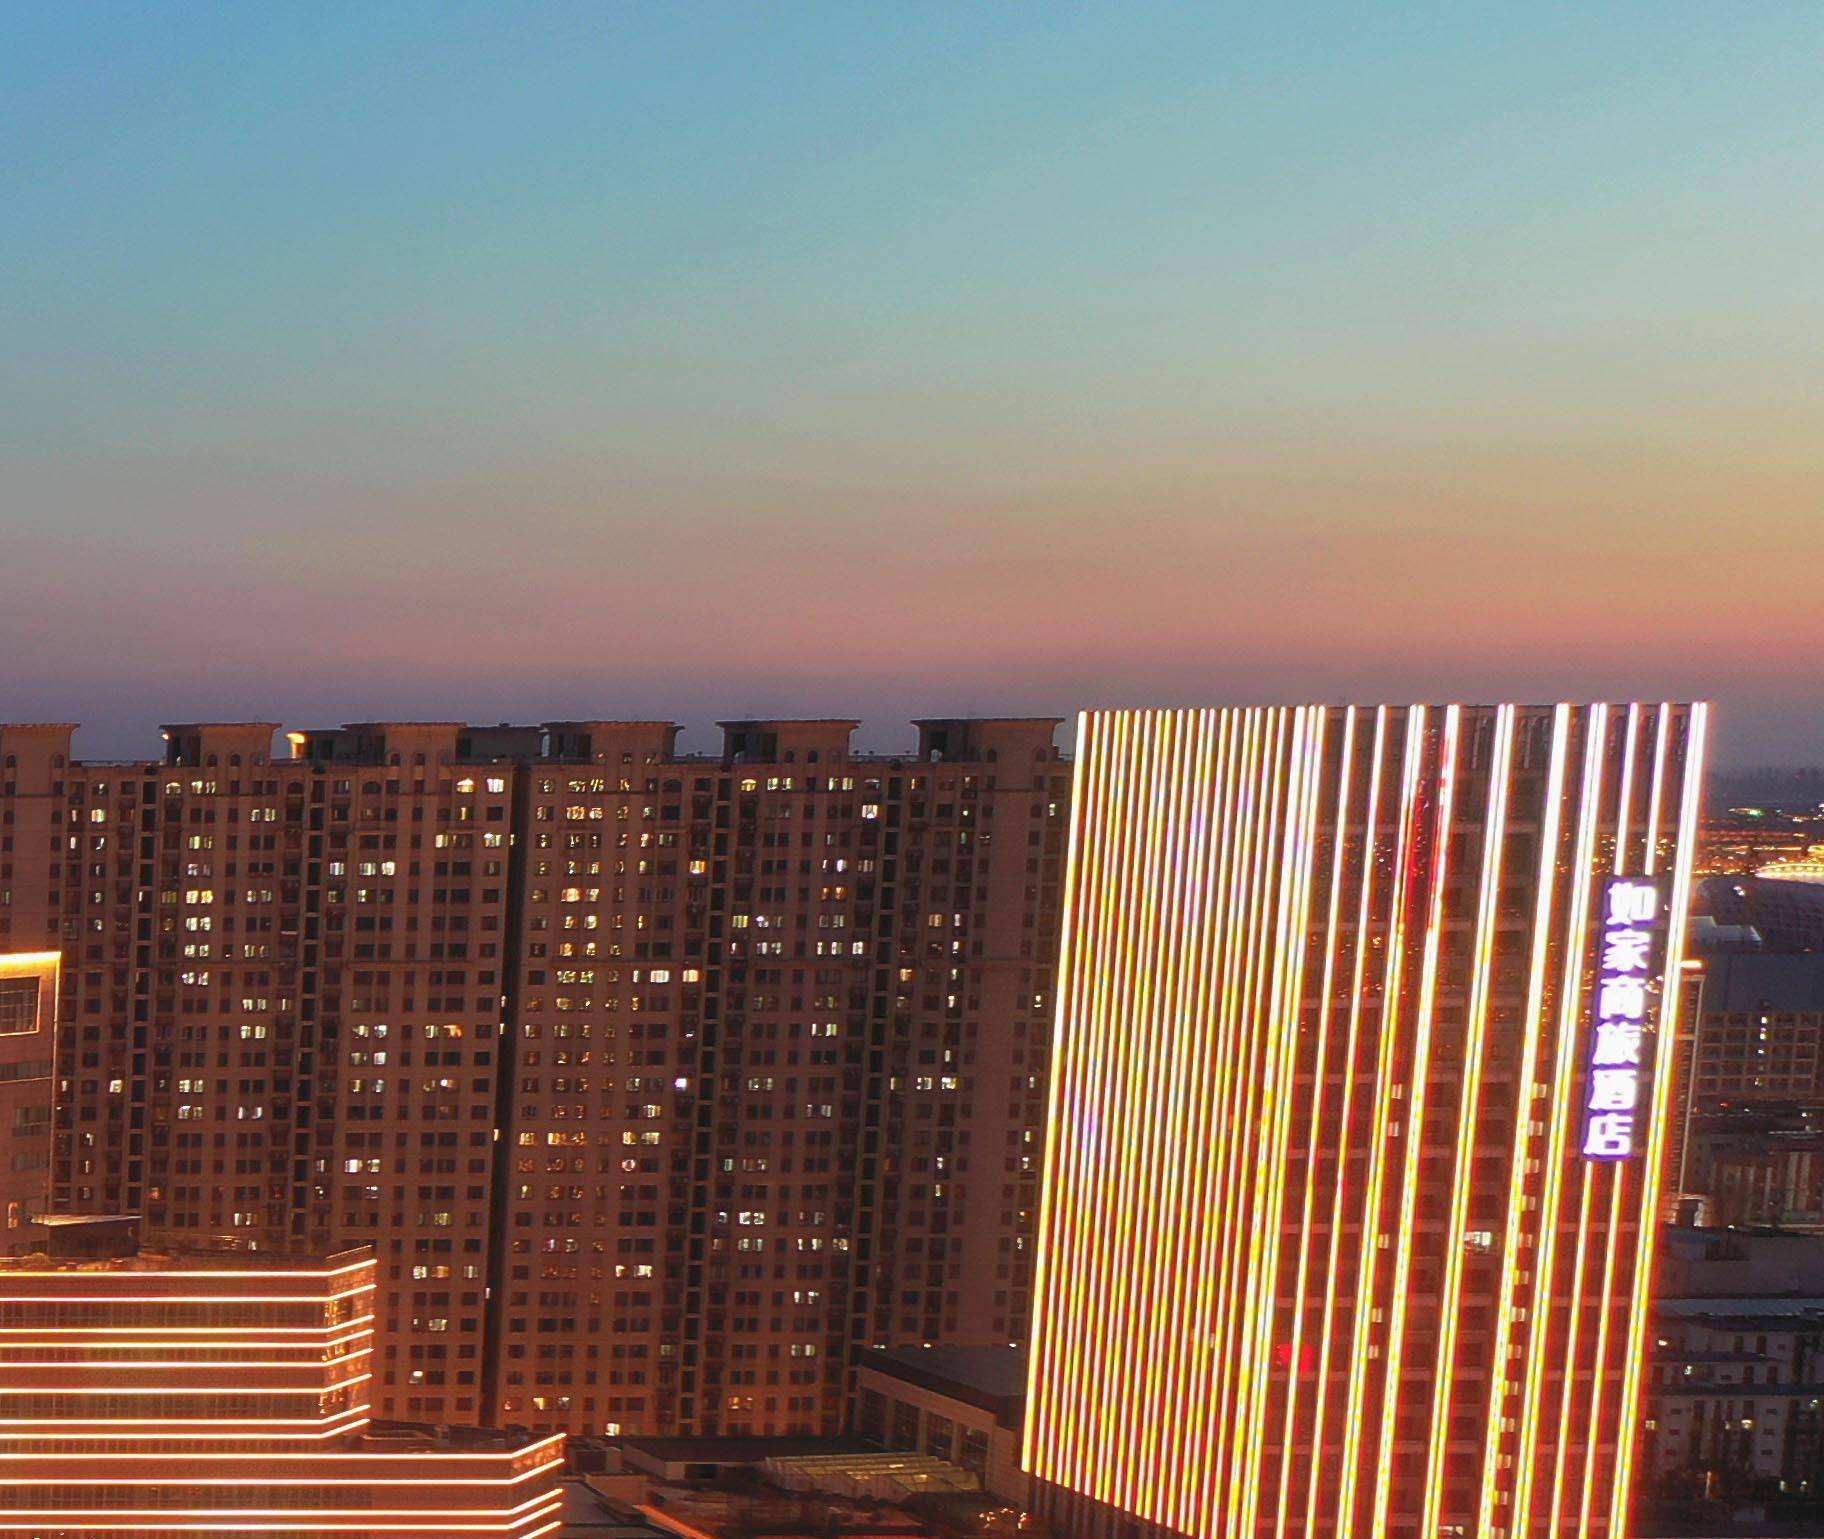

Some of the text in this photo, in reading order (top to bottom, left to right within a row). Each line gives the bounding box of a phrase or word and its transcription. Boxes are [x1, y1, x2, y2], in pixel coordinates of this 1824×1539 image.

[1583, 881, 1657, 1156] 如家商旅酒店
